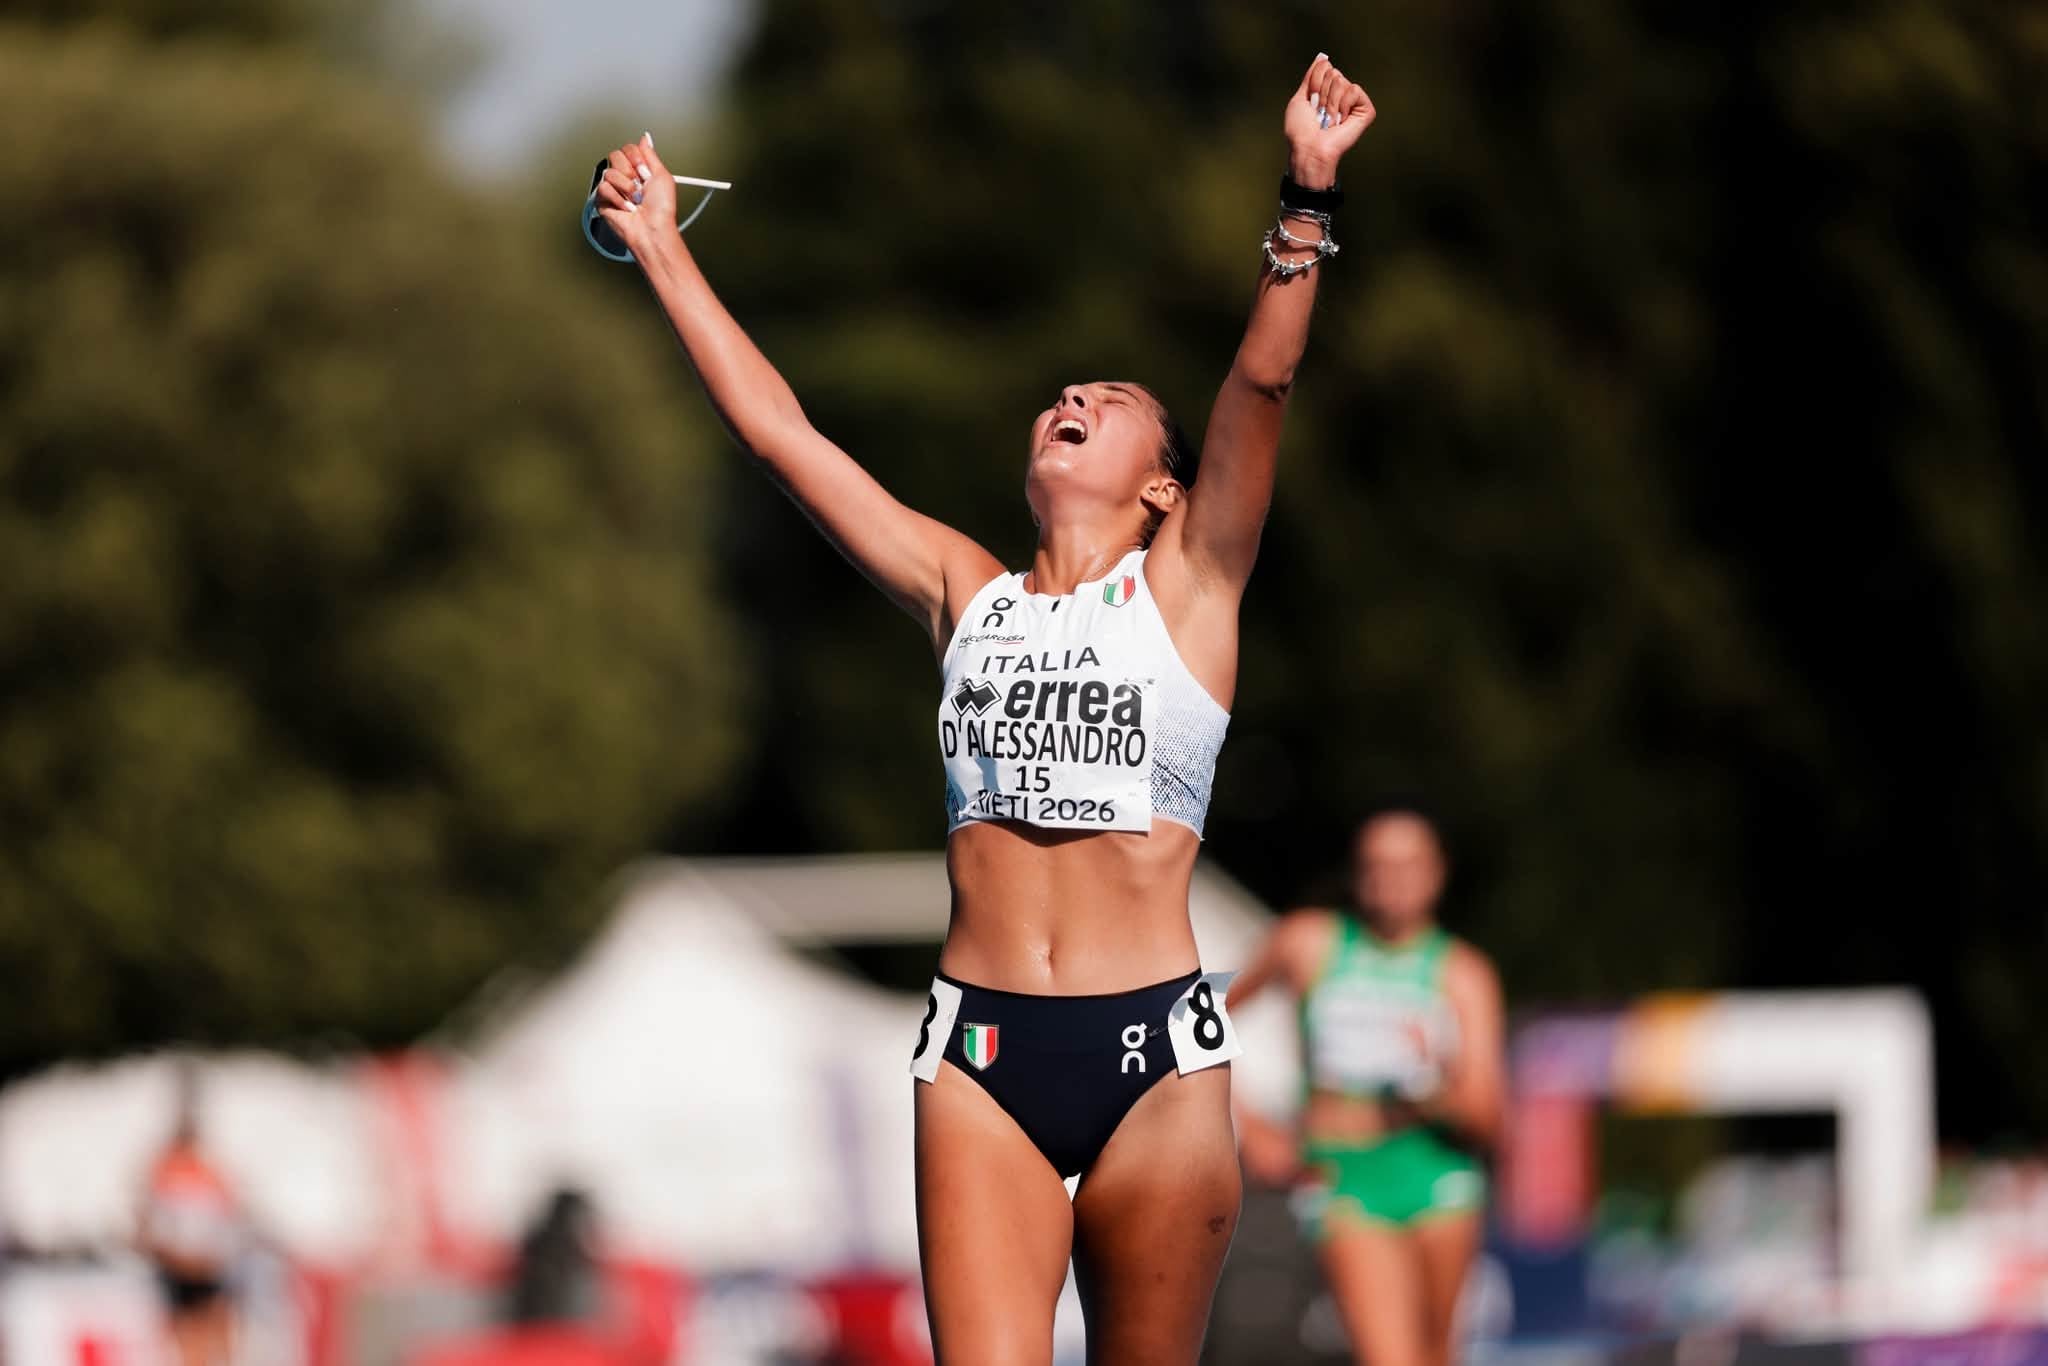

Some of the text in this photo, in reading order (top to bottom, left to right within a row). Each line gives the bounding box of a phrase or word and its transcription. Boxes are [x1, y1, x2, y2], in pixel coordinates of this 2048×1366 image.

[981, 646, 1101, 673] ITALIA
[942, 717, 1146, 767] D'ALESSANDRO
[1016, 765, 1051, 793] 15
[1038, 797, 1116, 823] 2026
[1187, 981, 1225, 1051] 8
